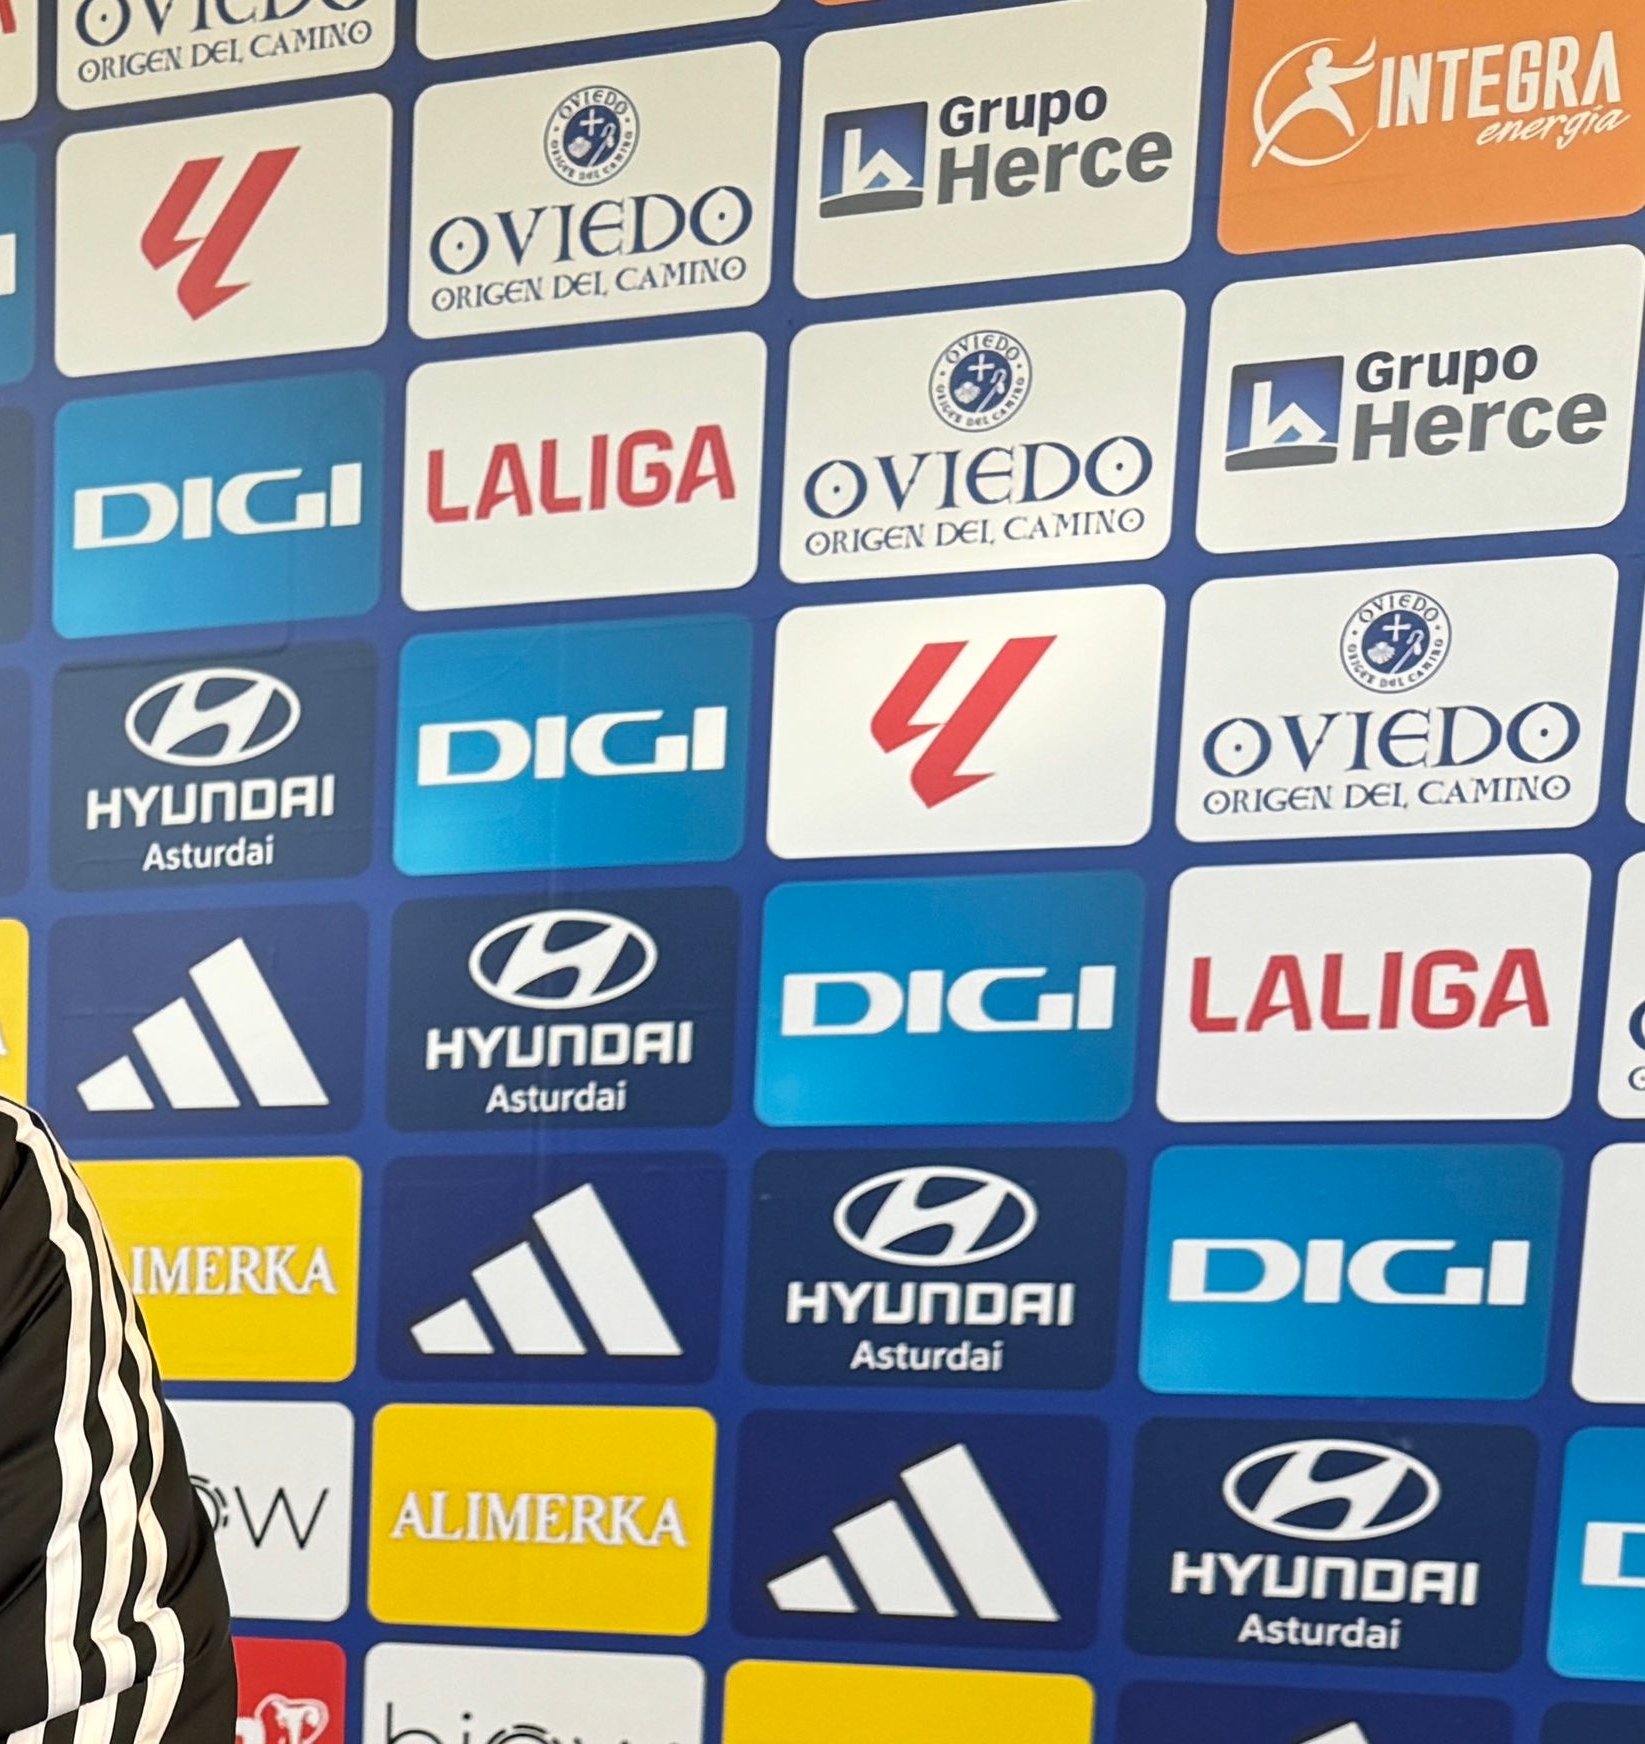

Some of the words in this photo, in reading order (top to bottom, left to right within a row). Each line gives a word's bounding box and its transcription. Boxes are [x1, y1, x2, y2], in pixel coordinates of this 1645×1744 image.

[77, 46, 182, 83] ORIGEN
[191, 40, 243, 68] DEL
[250, 20, 372, 58] CAMINO
[1377, 30, 1622, 131] INTEGRA
[939, 85, 1109, 138] Grupo
[937, 129, 1173, 205] Herce
[429, 185, 752, 275] OVIEDO
[431, 276, 543, 312] ORIGEN
[553, 272, 608, 300] DEL
[615, 256, 747, 291] CAMINO
[1355, 343, 1537, 394] Grupo
[1352, 392, 1607, 461] Herce
[427, 423, 736, 524] LALIGA
[804, 435, 1153, 518] OVIEDO
[74, 462, 362, 551] DIGI
[805, 523, 925, 556] ORIGEN
[936, 518, 995, 547] DEL
[1004, 506, 1145, 541] CAMINO
[1359, 594, 1439, 623] OVIEDO
[417, 706, 727, 786] DIGI
[1203, 701, 1581, 777] OVIEDO
[86, 774, 336, 830] HYUNDAI
[1203, 784, 1332, 814] ORIGEN
[1344, 782, 1408, 810] DEL
[1418, 774, 1571, 806] CAMINO
[142, 834, 274, 872] Asturdai
[780, 965, 1117, 1036] DIGI
[1189, 948, 1549, 1033] LALIGA
[425, 1021, 693, 1070] HYUNDAI
[485, 1079, 627, 1115] Asturdai
[1169, 1238, 1531, 1306] DIGI
[786, 1281, 1075, 1326] HYUNDAI
[849, 1340, 1003, 1372] Asturdai
[390, 1490, 689, 1549] ALIMERKA
[1170, 1550, 1479, 1607] HYUNDAI
[1237, 1613, 1401, 1650] Asturdai
